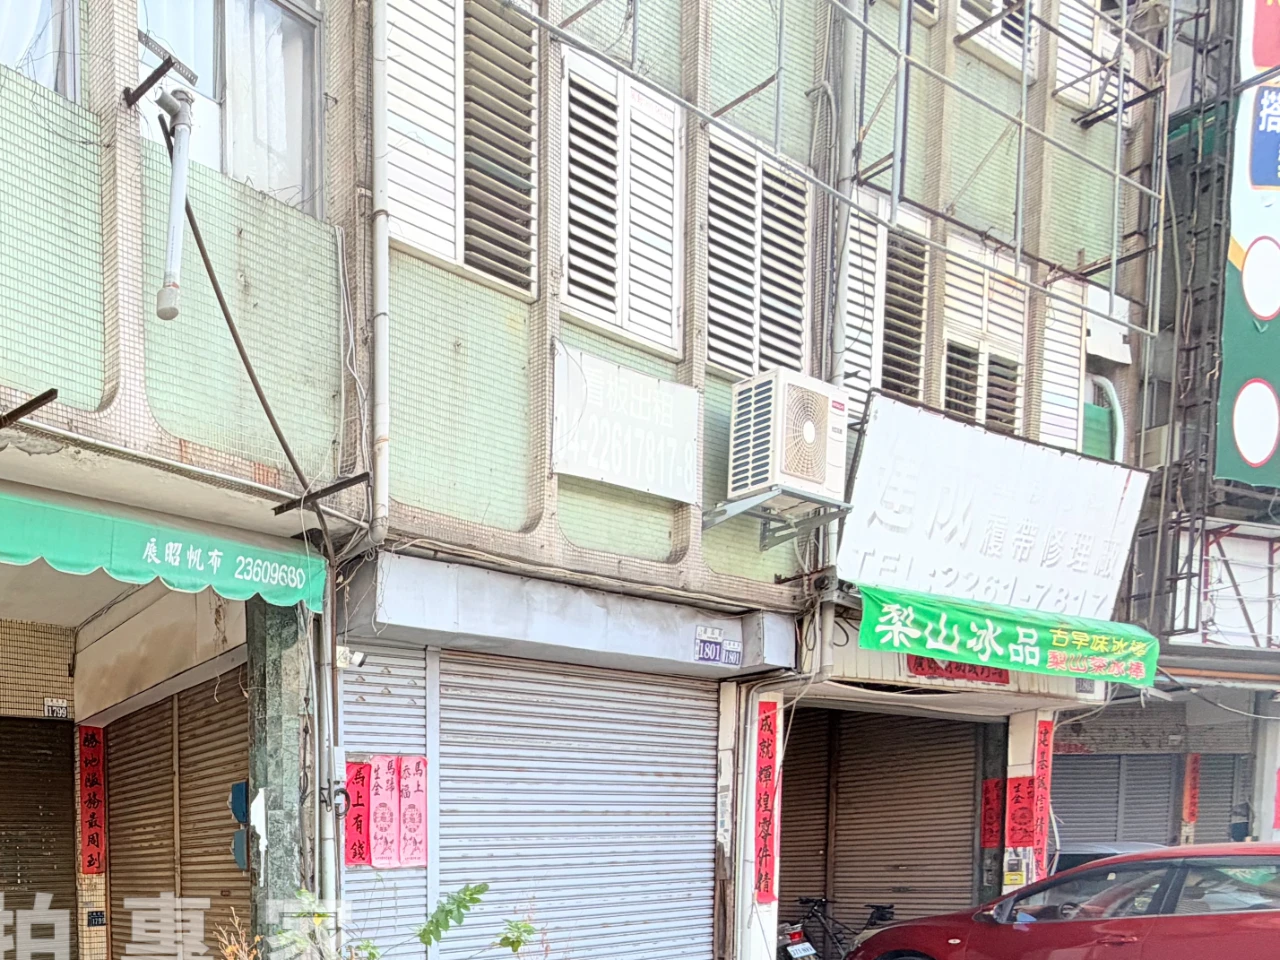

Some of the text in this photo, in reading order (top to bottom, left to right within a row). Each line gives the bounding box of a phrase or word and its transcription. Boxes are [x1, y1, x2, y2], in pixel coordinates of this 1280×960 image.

[235, 556, 306, 589] 23609680
[700, 642, 720, 660] 1801
[875, 603, 1040, 667] 梨山冰品
[1046, 649, 1147, 680] 梨山茶冰棒
[48, 706, 67, 718] 1799
[351, 767, 366, 861] 馬上有錢
